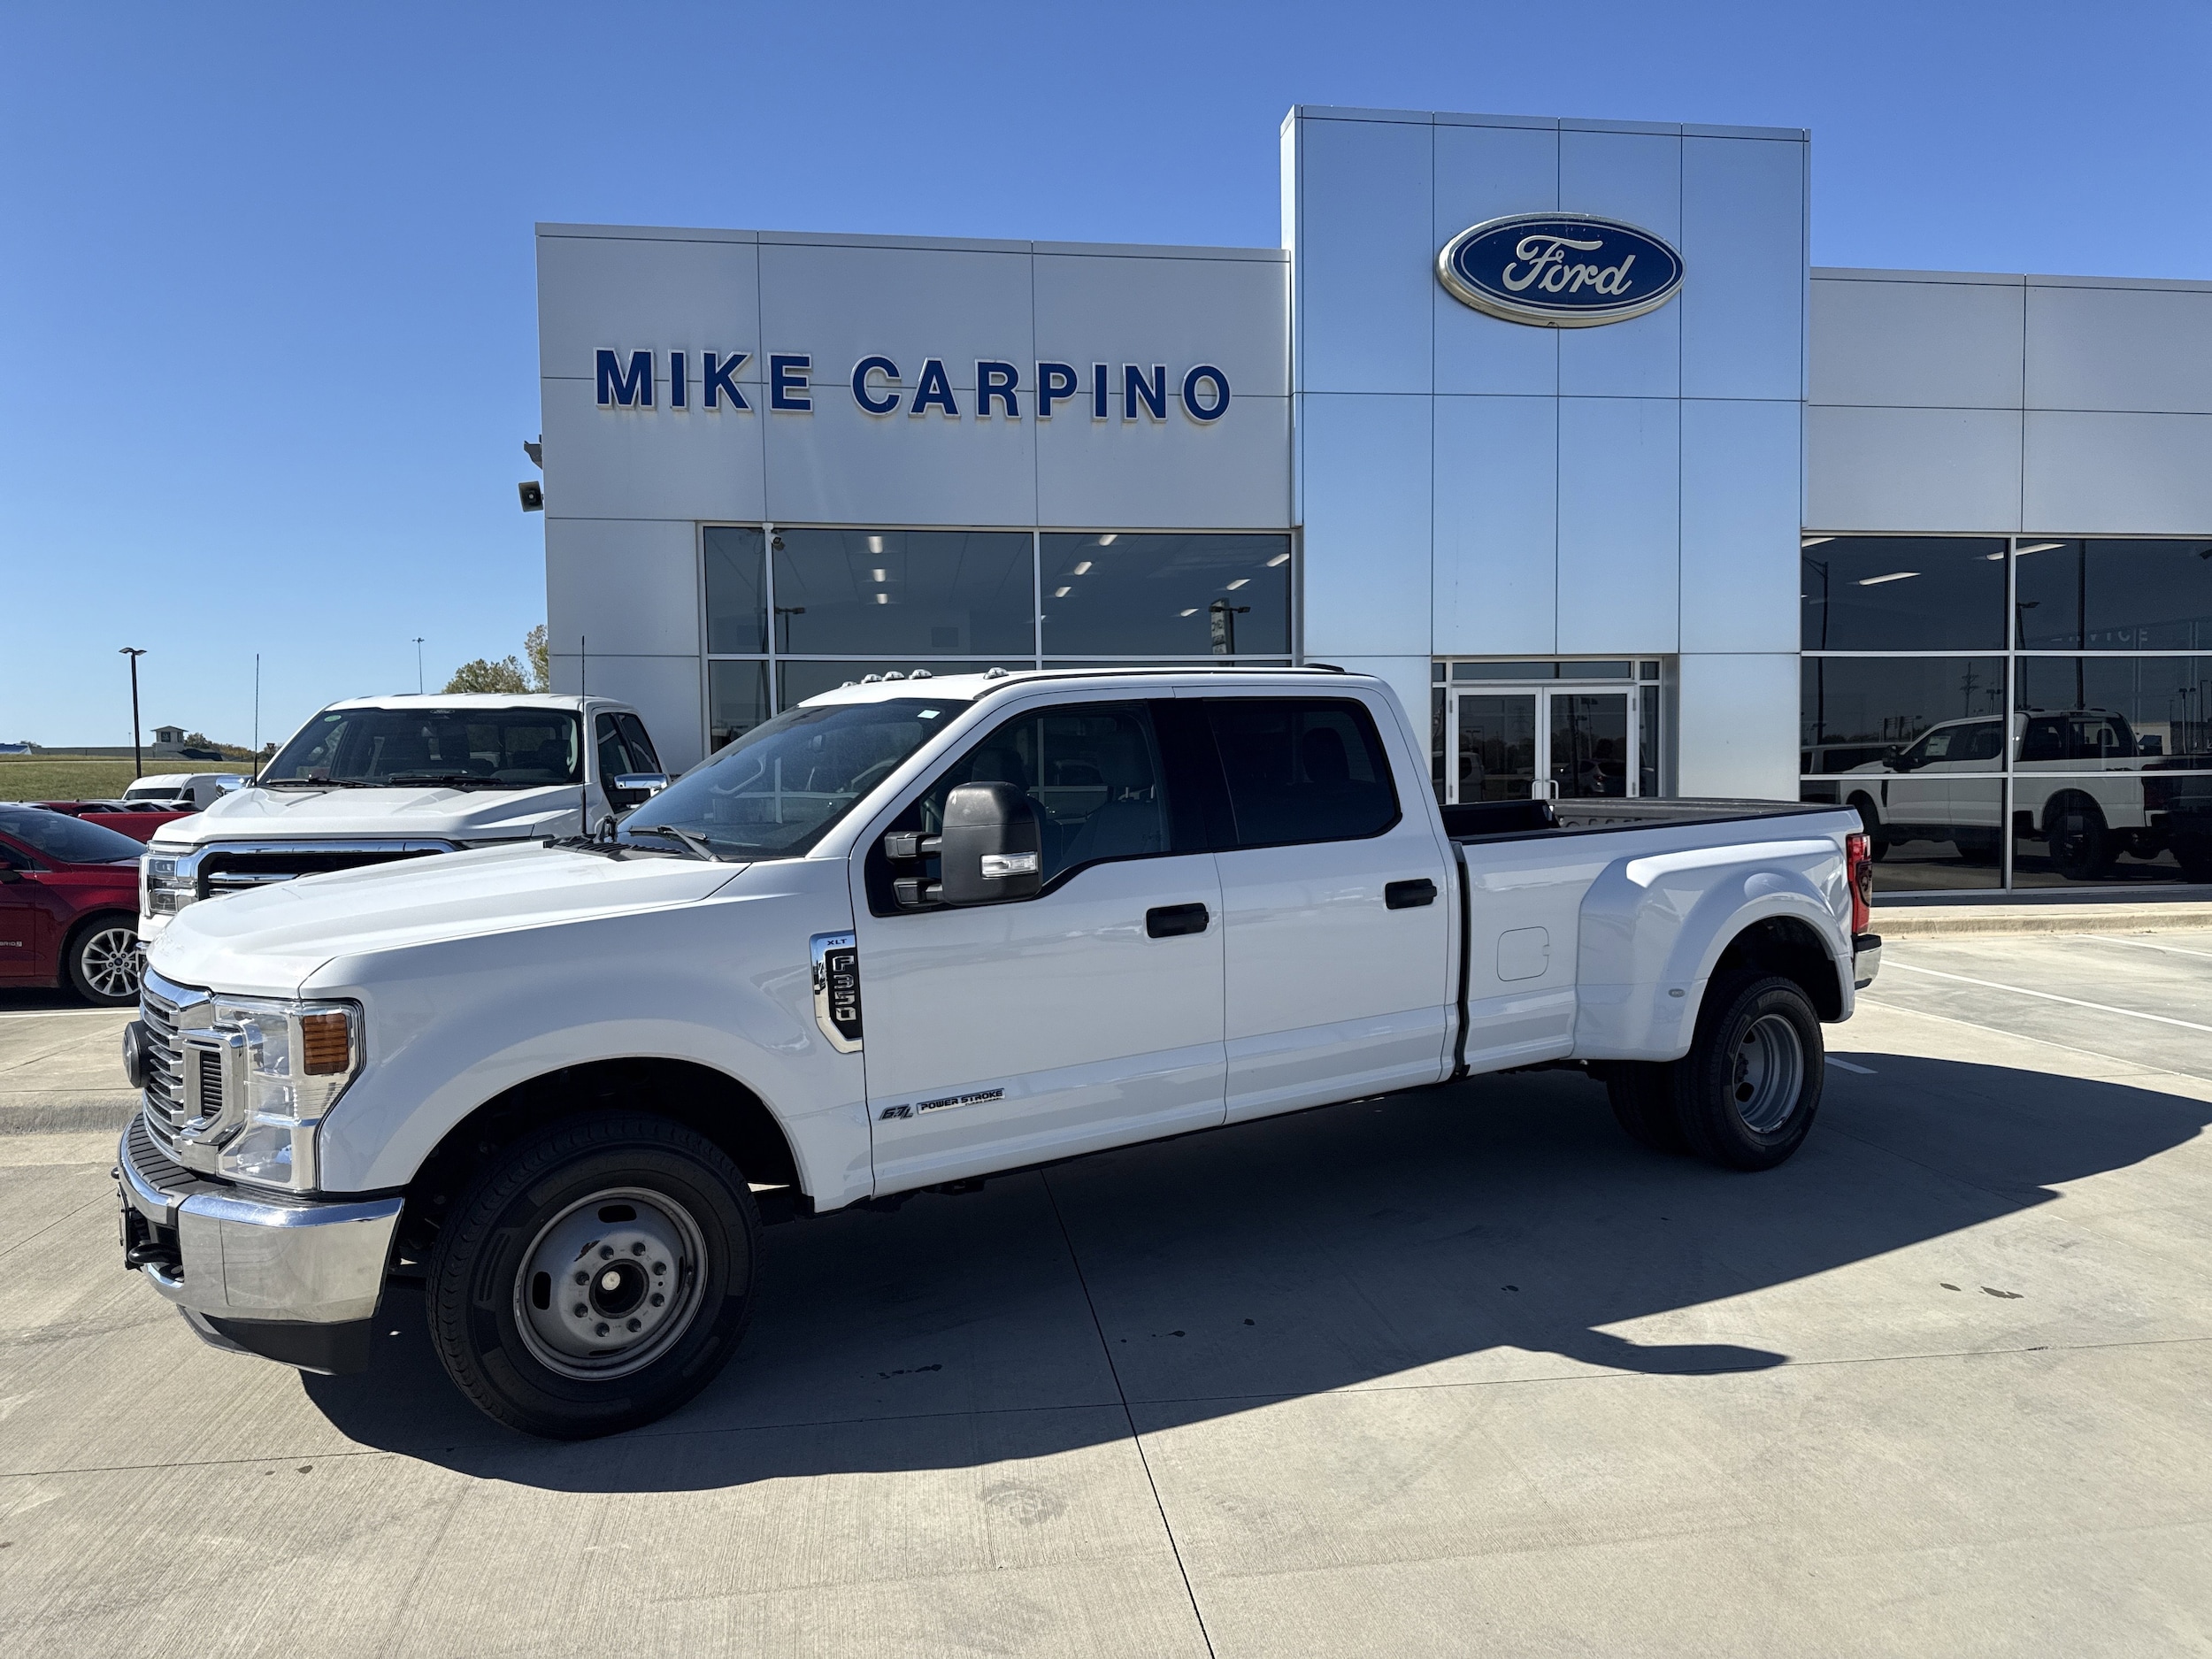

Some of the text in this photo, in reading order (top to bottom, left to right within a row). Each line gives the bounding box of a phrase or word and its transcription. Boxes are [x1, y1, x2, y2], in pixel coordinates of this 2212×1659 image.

[1502, 234, 1636, 295] Ford
[594, 347, 1232, 426] MIKE CARPINO
[920, 1089, 1003, 1110] POWER STROKE
